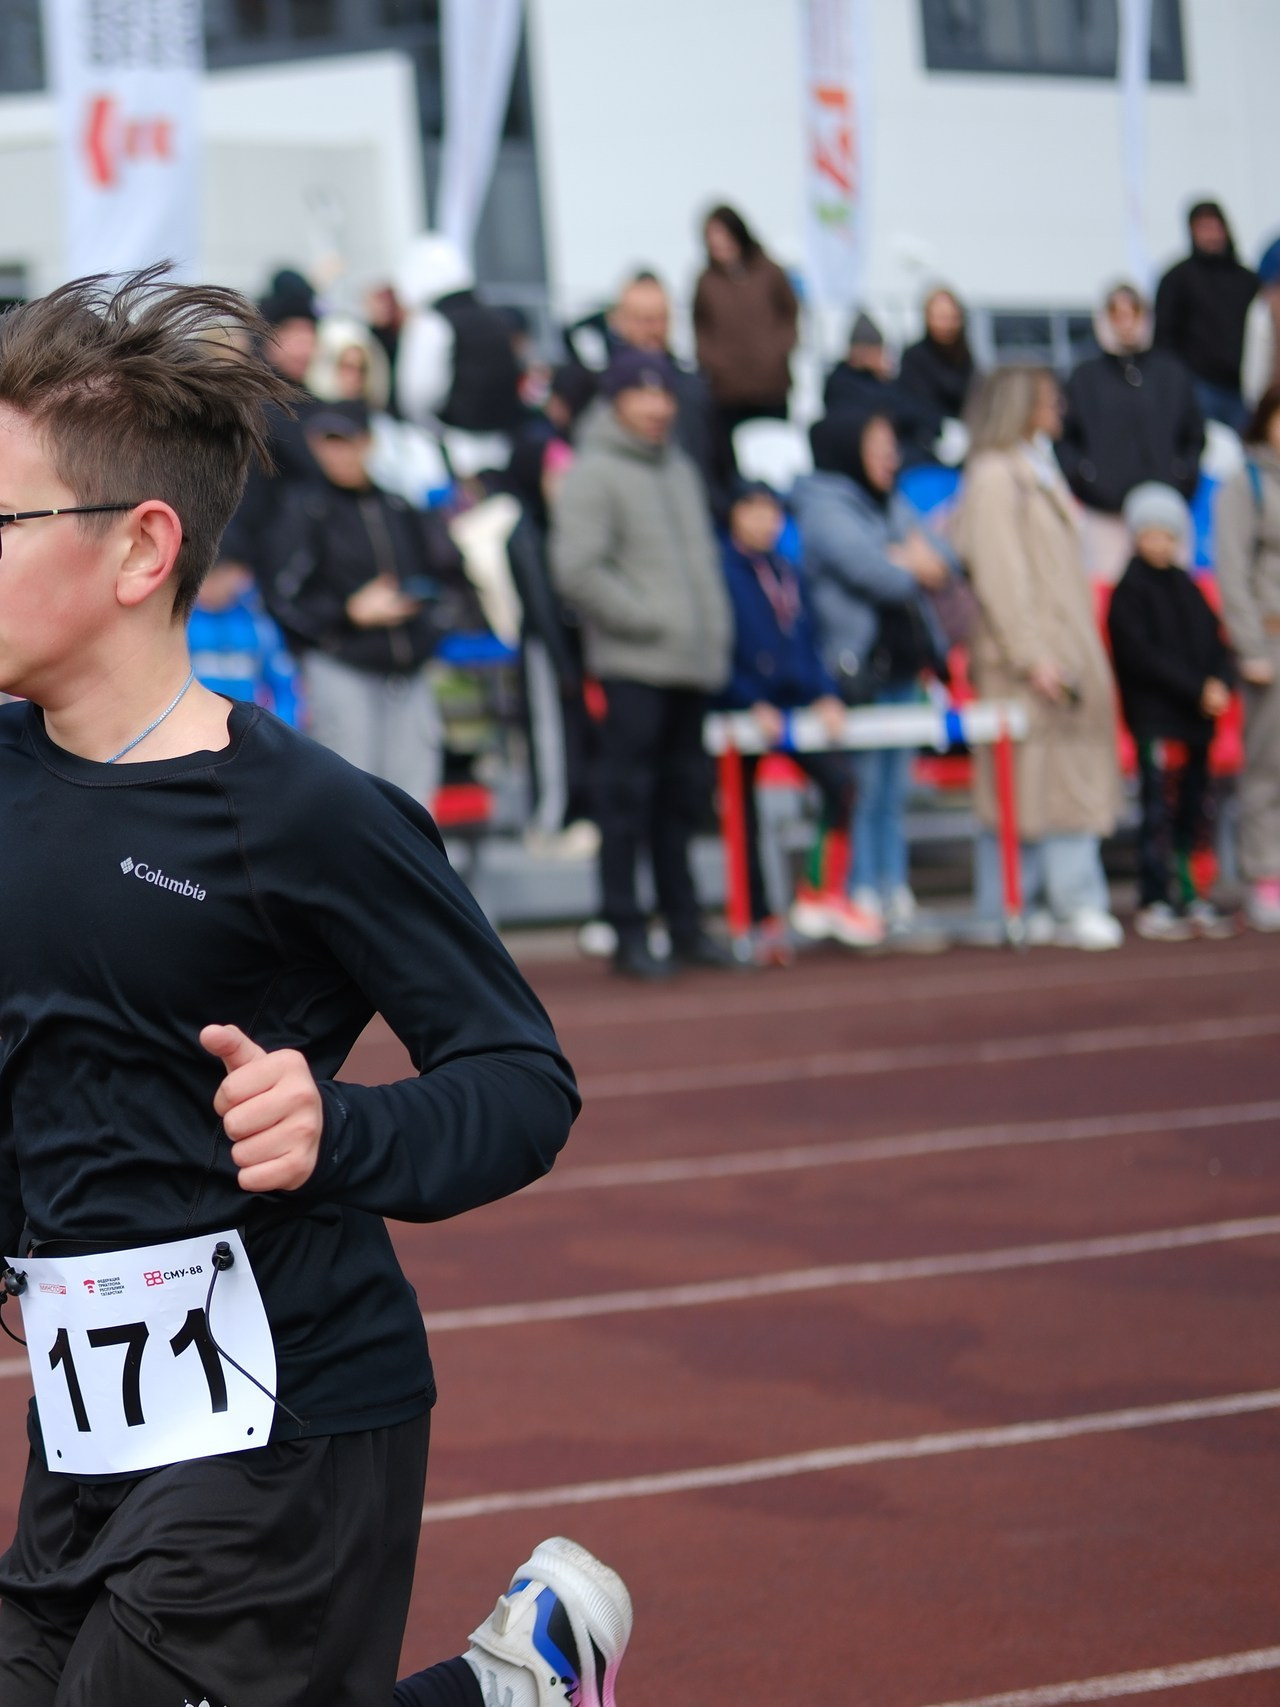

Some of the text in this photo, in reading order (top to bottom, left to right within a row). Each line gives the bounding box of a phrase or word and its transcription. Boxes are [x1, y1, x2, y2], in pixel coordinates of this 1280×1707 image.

[134, 863, 206, 901] Columbia
[163, 1265, 203, 1280] СМУ-88
[48, 1307, 228, 1432] 171
